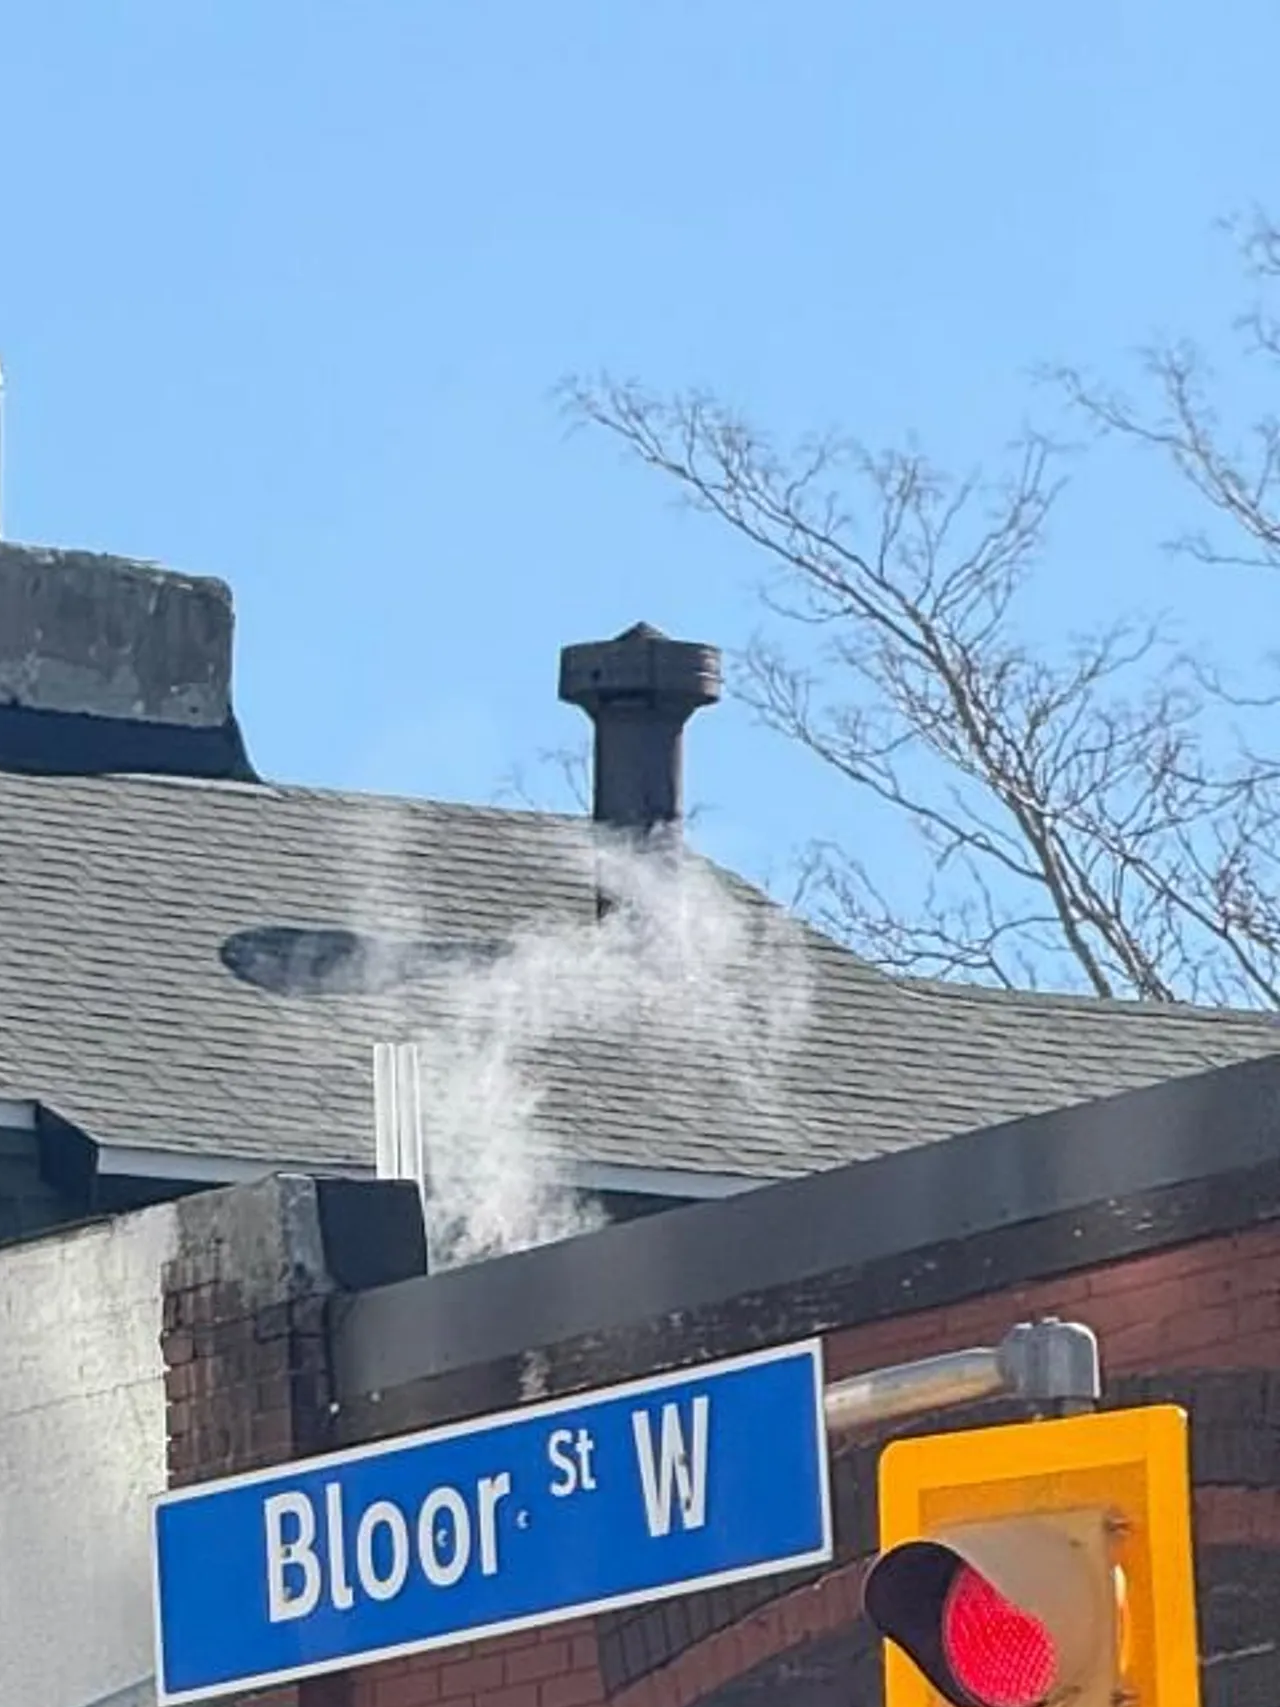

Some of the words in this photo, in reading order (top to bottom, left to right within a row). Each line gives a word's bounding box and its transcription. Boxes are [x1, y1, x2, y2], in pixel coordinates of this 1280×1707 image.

[264, 1472, 511, 1623] Bloor
[548, 1428, 597, 1498] St
[632, 1396, 710, 1539] W
